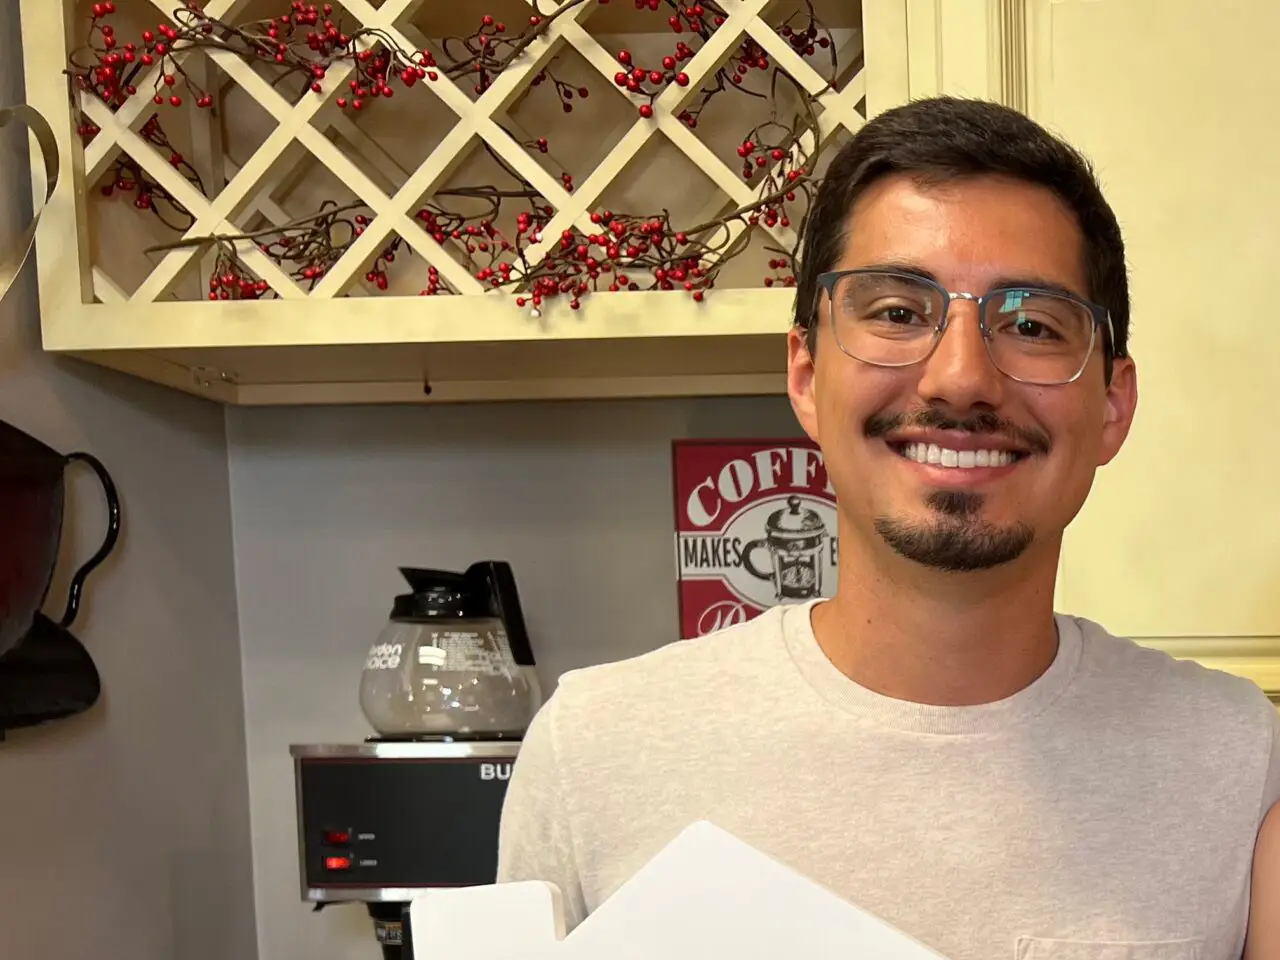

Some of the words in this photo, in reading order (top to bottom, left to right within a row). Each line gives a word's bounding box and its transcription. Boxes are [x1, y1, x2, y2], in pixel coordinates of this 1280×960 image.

[687, 447, 836, 527] COFF
[684, 538, 743, 568] MAKES
[481, 763, 510, 780] BU
